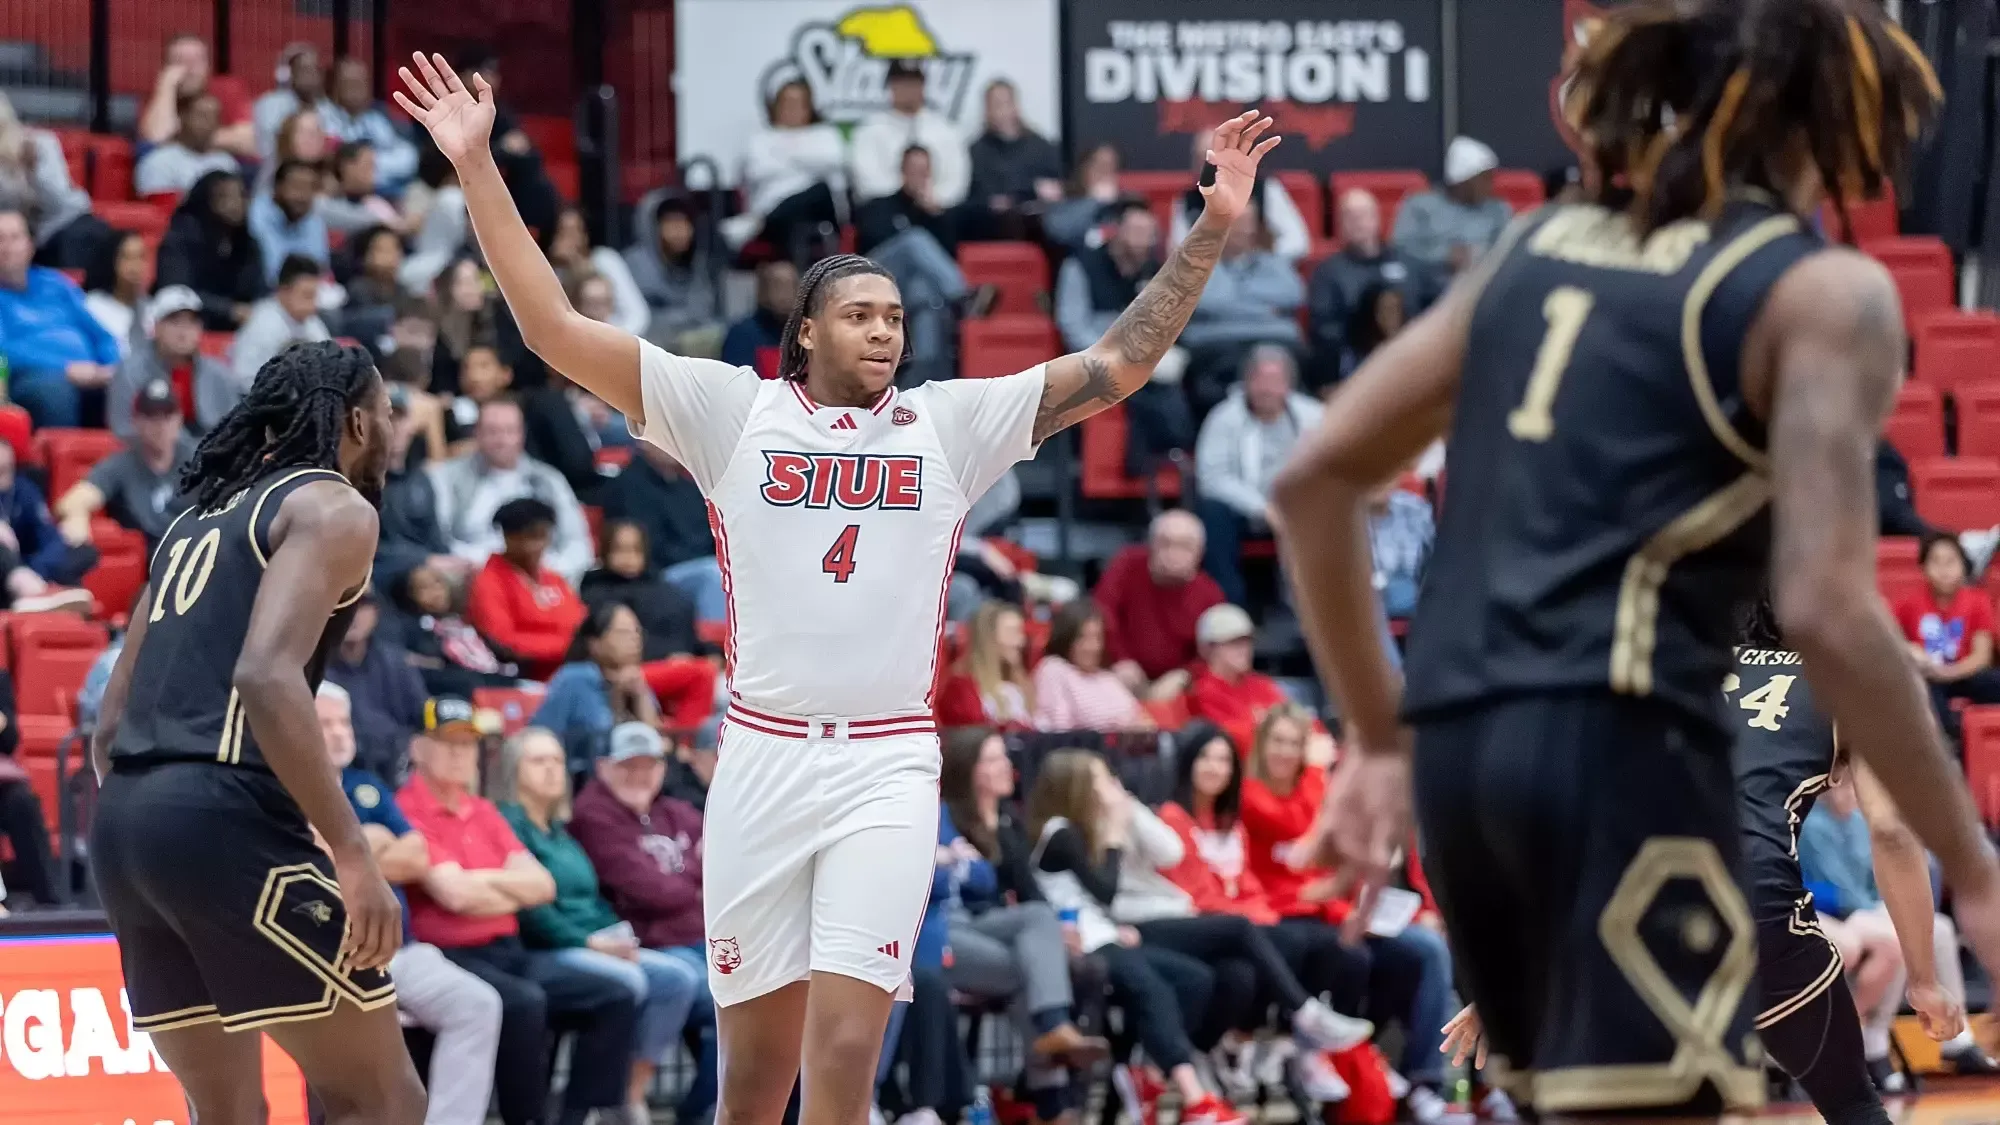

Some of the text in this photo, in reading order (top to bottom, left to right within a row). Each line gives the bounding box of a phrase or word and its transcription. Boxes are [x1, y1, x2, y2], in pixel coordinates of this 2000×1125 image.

[1108, 20, 1404, 52] THE METRO EAST'S
[1085, 48, 1430, 103] DIVISION I
[1507, 286, 1595, 443] 1
[760, 450, 922, 511] SIUE
[149, 528, 221, 623] 10
[822, 525, 860, 583] 4
[821, 723, 836, 738] E
